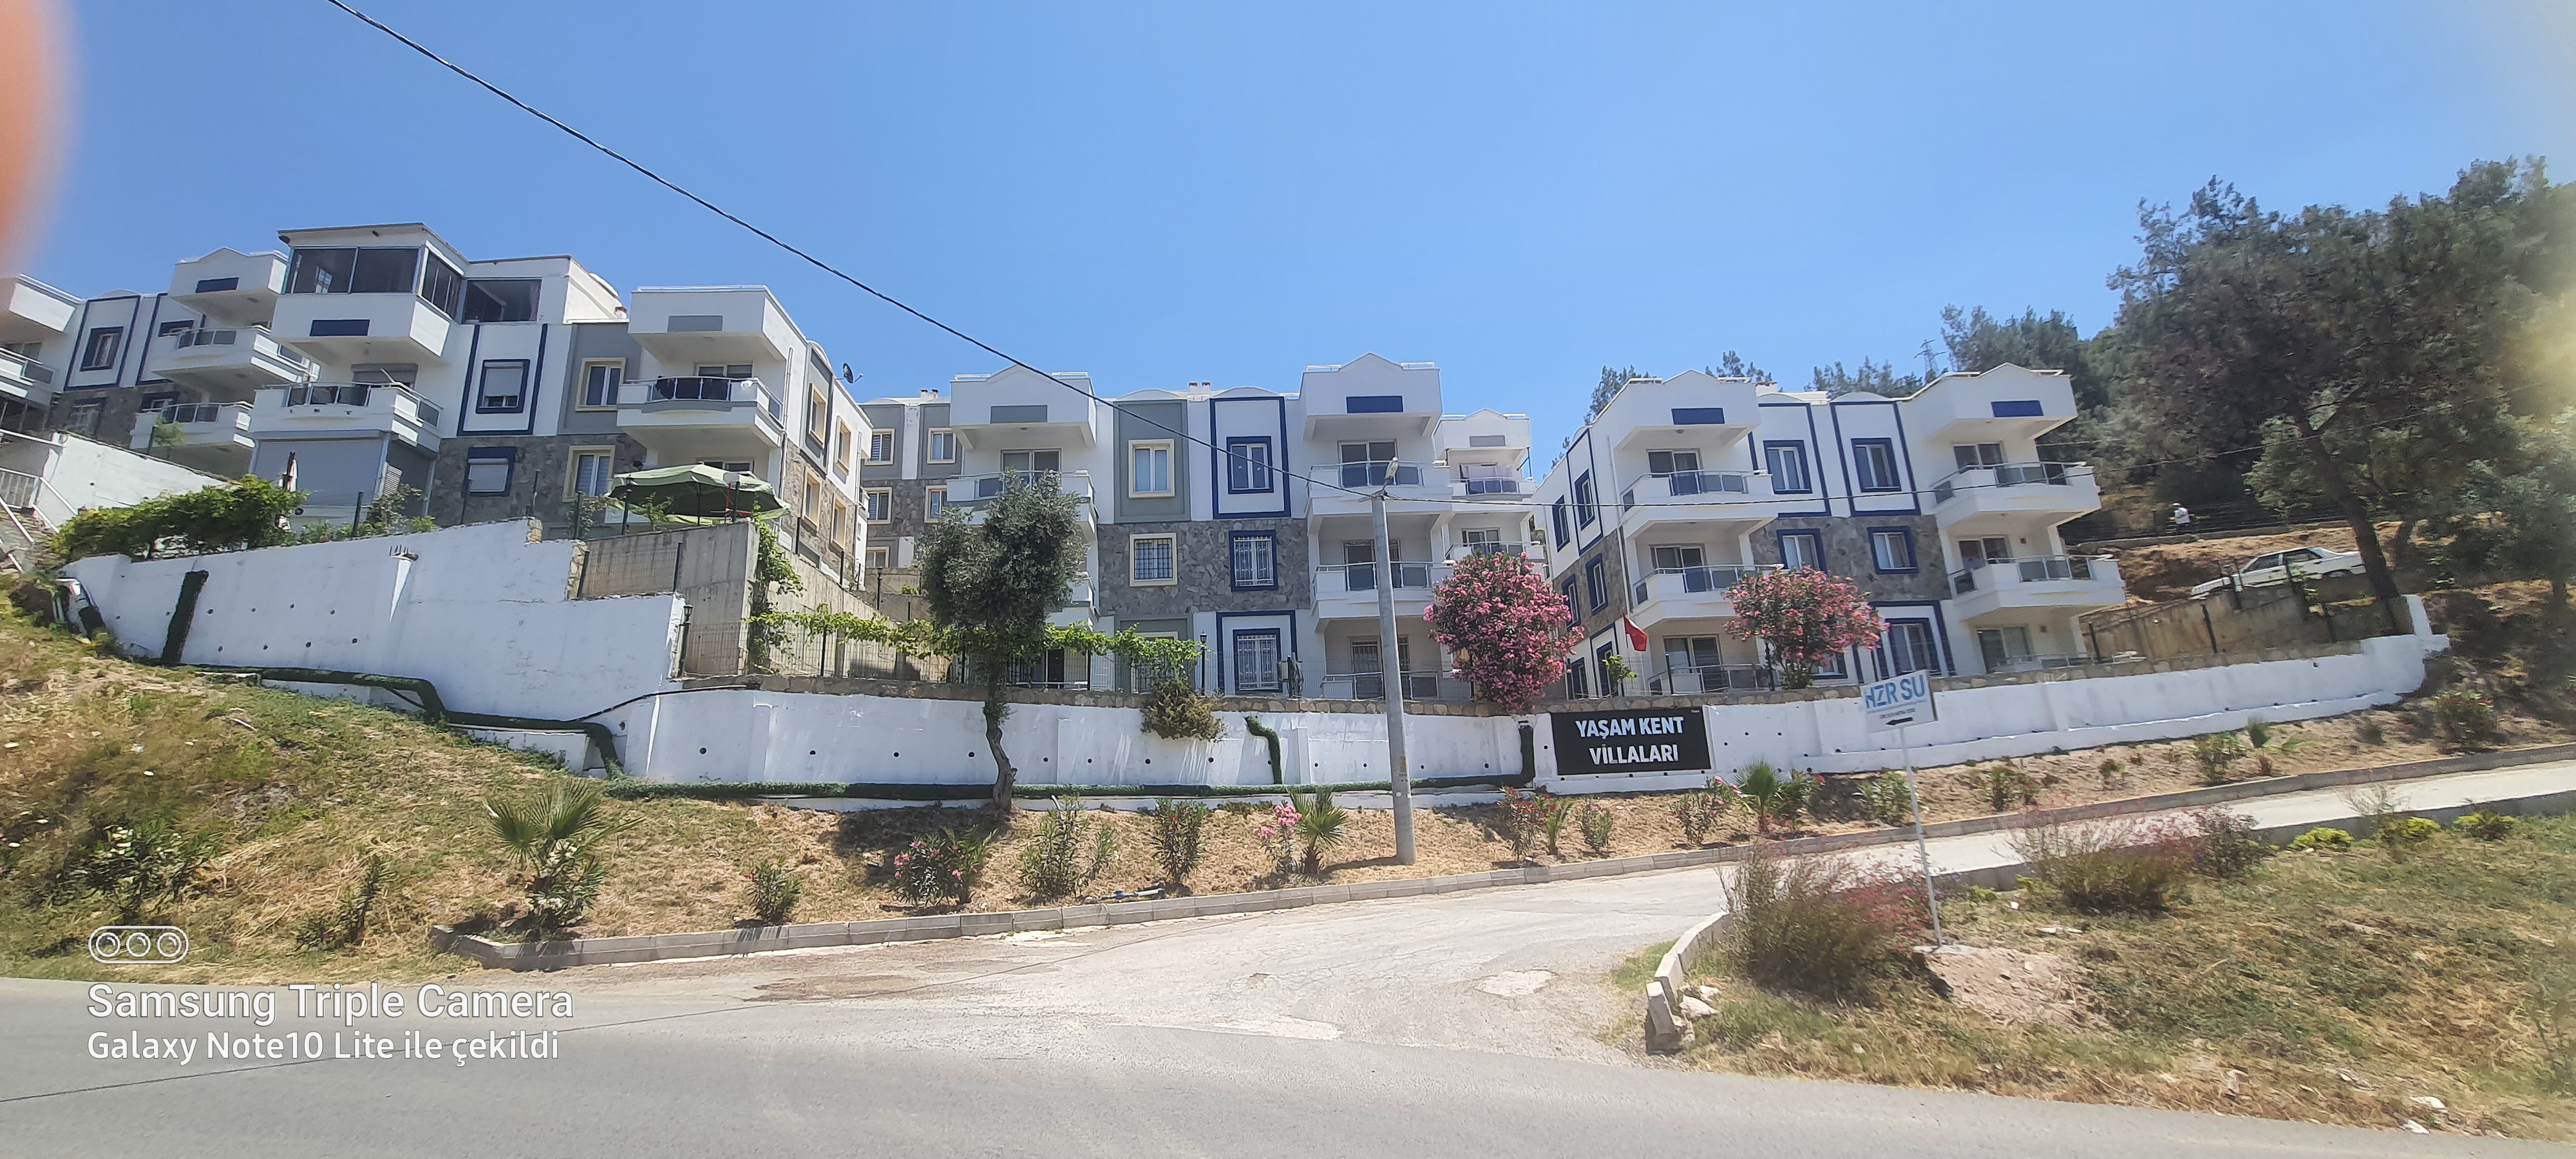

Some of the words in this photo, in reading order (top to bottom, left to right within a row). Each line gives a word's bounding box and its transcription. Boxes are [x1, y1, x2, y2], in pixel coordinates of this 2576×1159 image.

[1900, 674, 1925, 701] SU
[1575, 719, 1636, 739] YAŞAM
[1638, 716, 1684, 735] KENT
[1588, 744, 1679, 765] VİLLALARI
